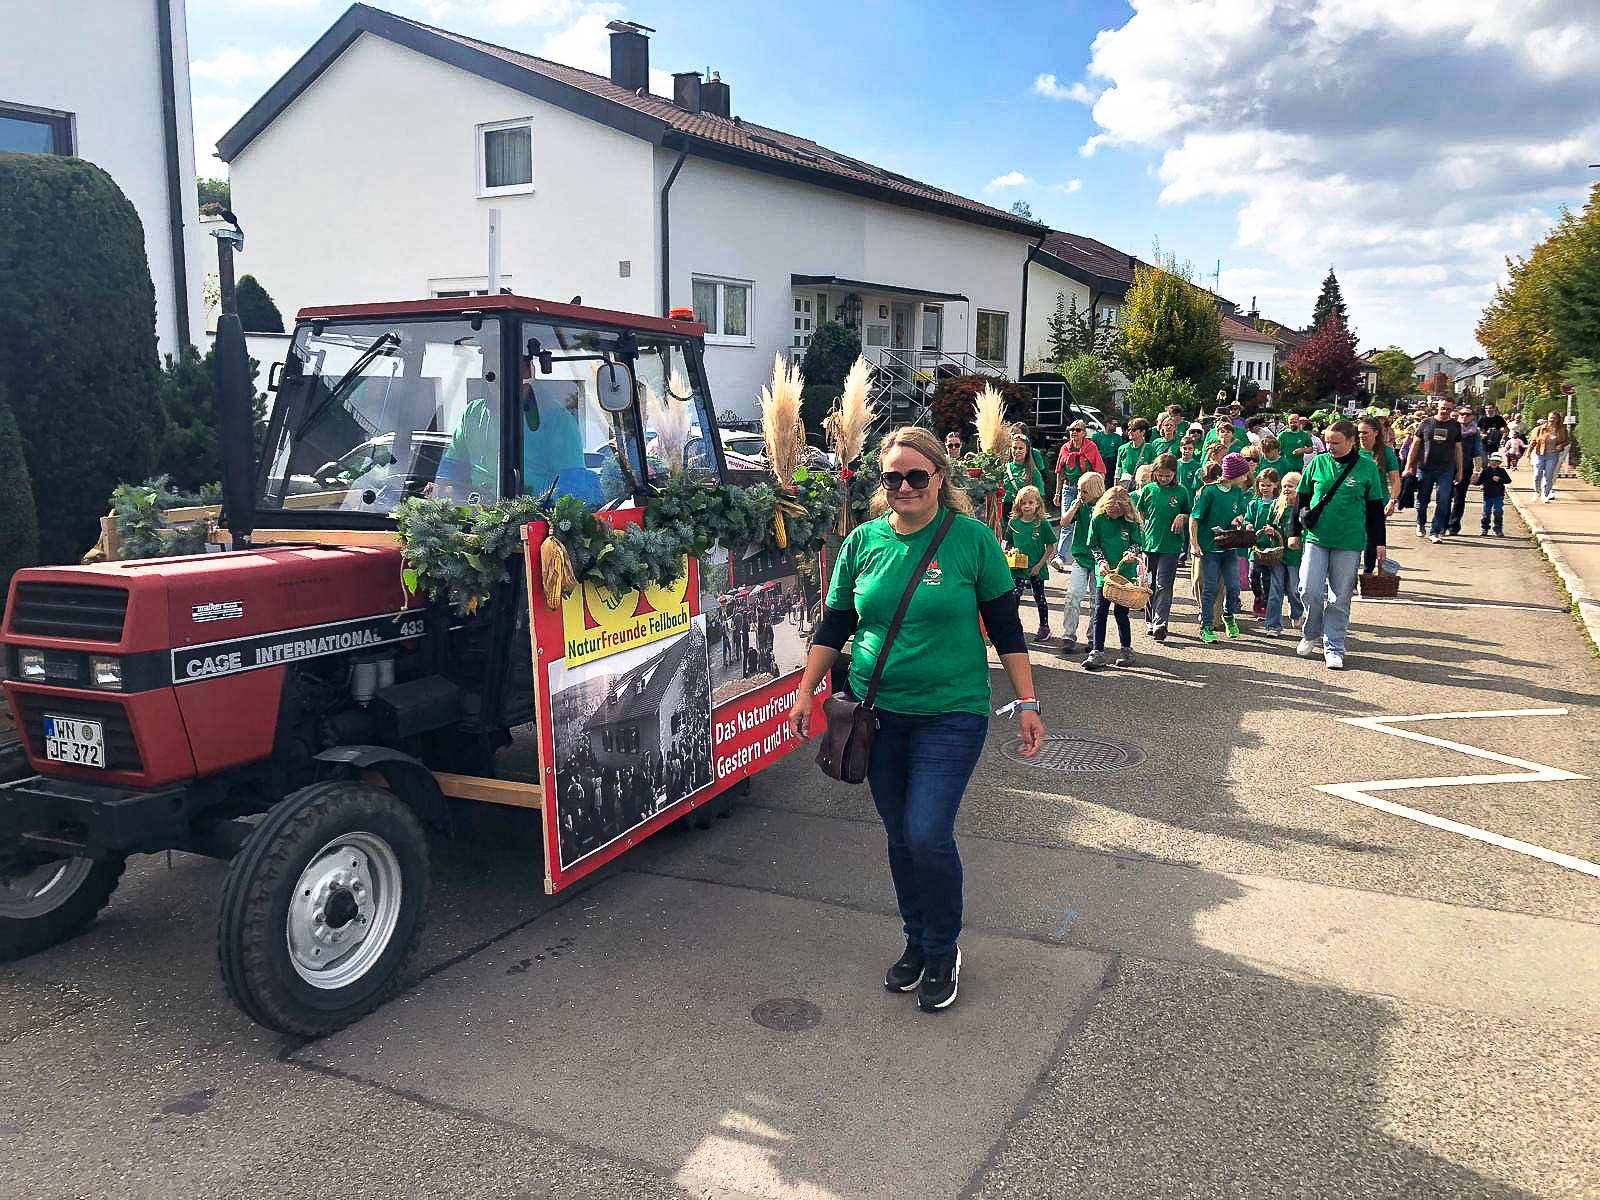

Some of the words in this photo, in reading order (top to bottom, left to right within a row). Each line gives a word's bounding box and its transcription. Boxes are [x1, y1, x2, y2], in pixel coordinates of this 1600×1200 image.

[186, 652, 242, 677] CASE
[255, 628, 382, 664] INTERNATIONAL
[400, 620, 424, 636] 433
[567, 620, 647, 659] NaturFreunde
[648, 607, 688, 635] Fellbach
[55, 720, 75, 740] WN
[715, 719, 736, 745] Das
[50, 740, 68, 760] JF
[72, 742, 99, 765] 372
[717, 741, 761, 779] Gestern
[763, 724, 781, 755] und
